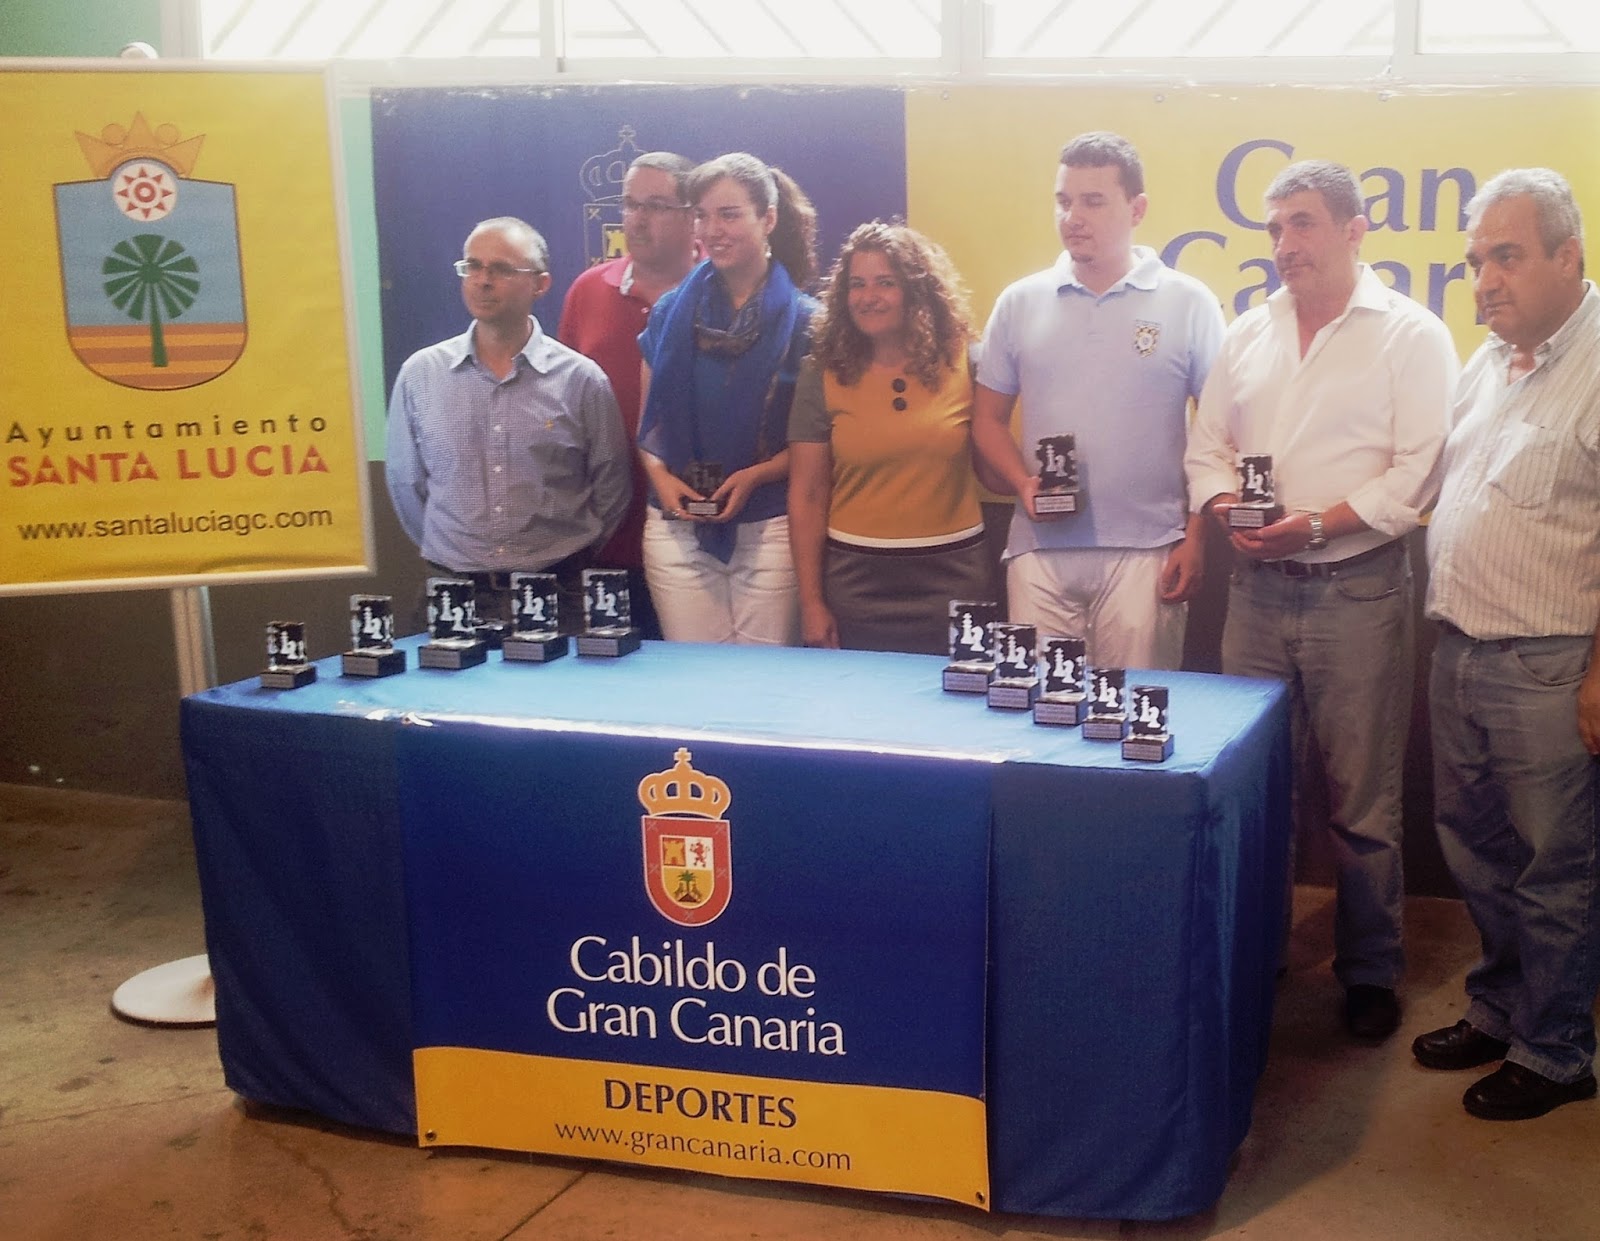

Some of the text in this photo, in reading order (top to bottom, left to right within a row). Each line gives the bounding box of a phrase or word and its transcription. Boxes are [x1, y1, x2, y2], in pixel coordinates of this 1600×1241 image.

[1216, 139, 1477, 231] Gan
[6, 414, 327, 448] Ayuntamiento
[7, 445, 331, 488] SANTA LUCIA
[19, 508, 333, 540] www.santaluciagc.com
[570, 935, 816, 997] Cabildo de
[547, 987, 846, 1055] Gran Canaria
[604, 1078, 797, 1128] DEPORTES
[555, 1122, 851, 1171] www.grancanaria.com
